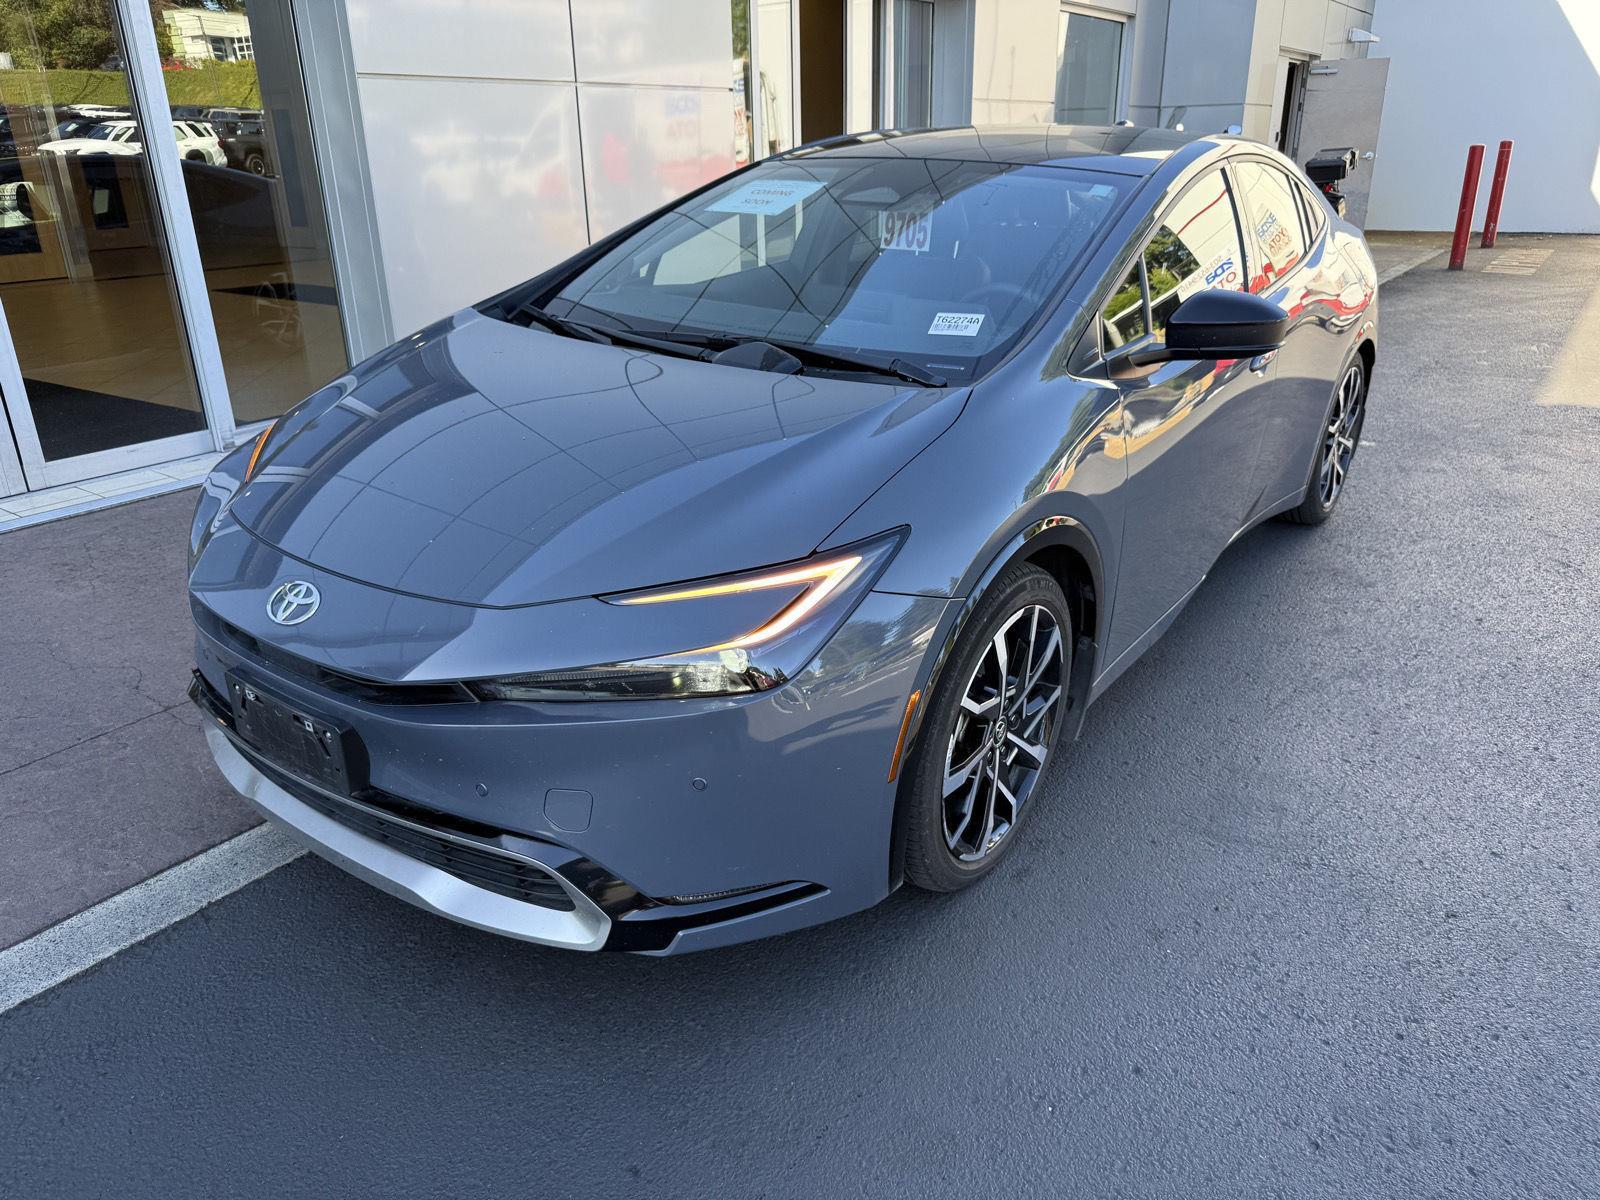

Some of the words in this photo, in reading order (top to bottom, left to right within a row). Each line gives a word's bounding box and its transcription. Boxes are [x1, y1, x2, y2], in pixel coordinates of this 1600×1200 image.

[751, 188, 796, 197] COMING
[741, 198, 774, 206] SOON
[883, 212, 928, 249] 9705
[936, 315, 980, 324] T62274A
